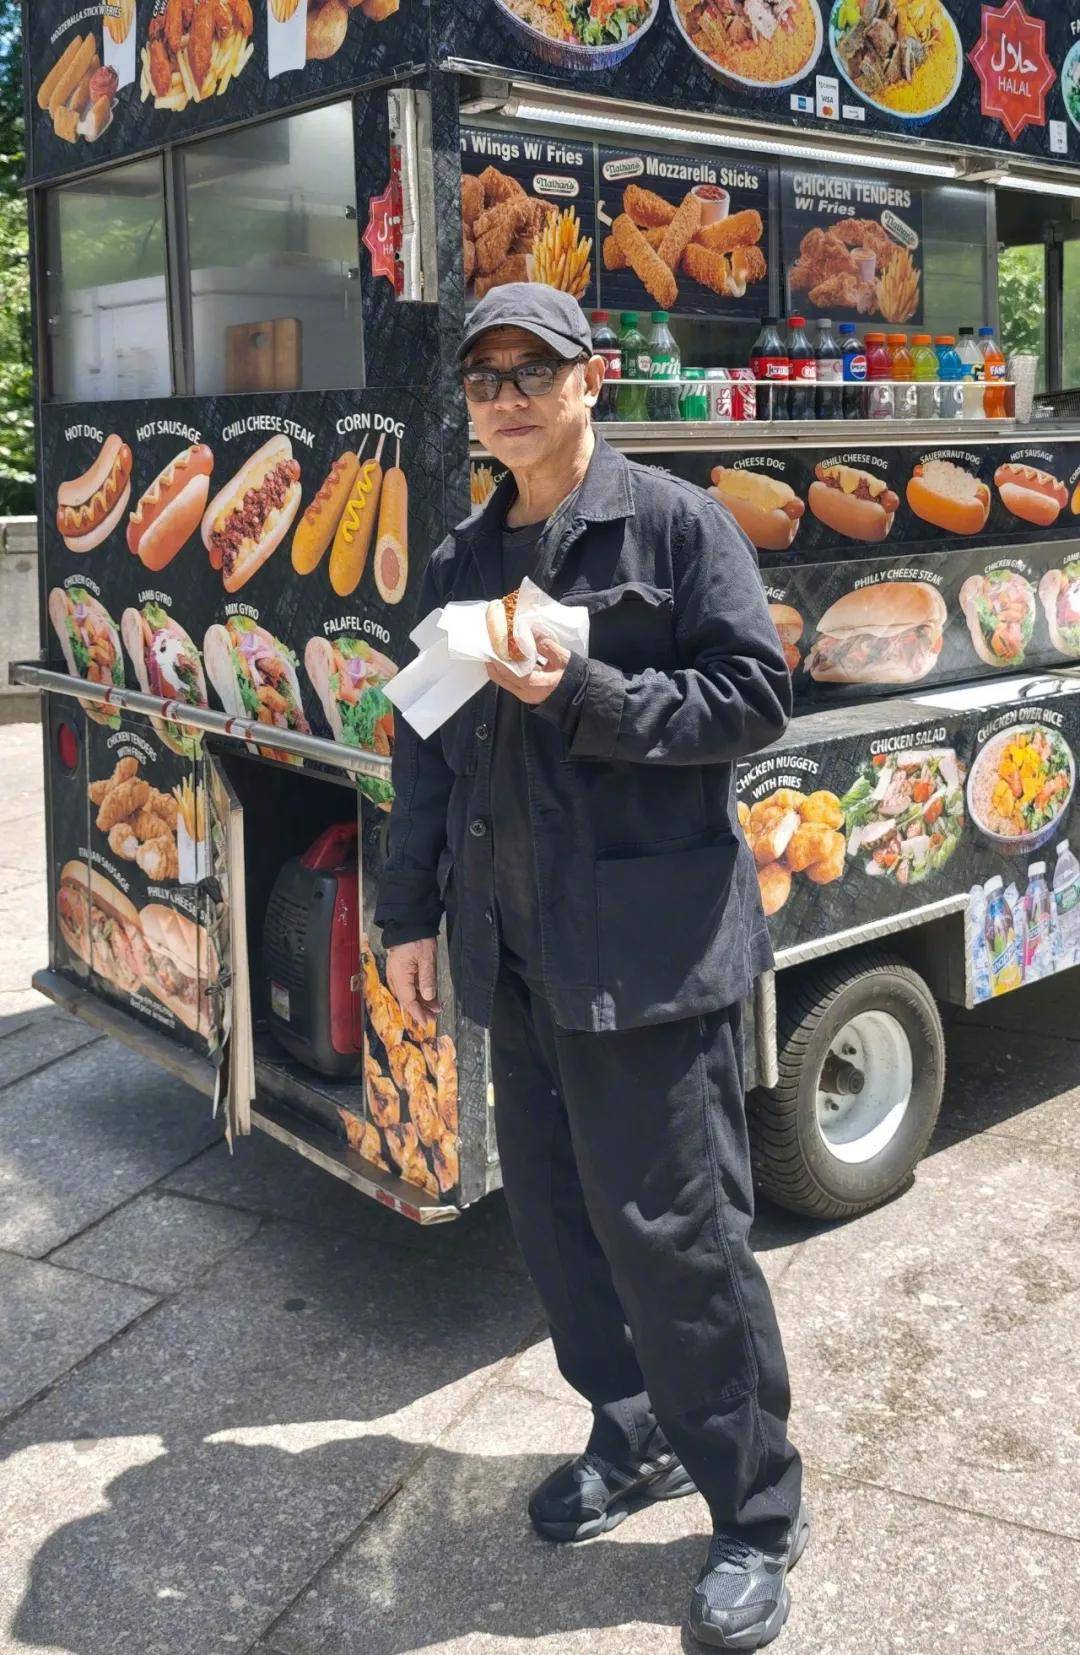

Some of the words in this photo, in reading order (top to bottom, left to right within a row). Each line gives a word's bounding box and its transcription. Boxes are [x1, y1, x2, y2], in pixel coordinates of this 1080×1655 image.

[990, 32, 1038, 74] حلال
[998, 76, 1031, 97] HALAL
[471, 135, 520, 161] Wings
[523, 142, 543, 160] W/
[547, 145, 584, 166] Fries
[536, 177, 575, 191] Nathan's
[646, 157, 717, 184] Mozzarella
[720, 168, 759, 190] Sticks
[793, 175, 851, 200] CHICKEN
[854, 183, 911, 208] TENDERS
[795, 197, 814, 211] W/
[817, 199, 855, 216] Fries
[65, 424, 82, 441] HOT
[83, 424, 103, 443] DOG
[136, 423, 157, 442] HOT
[157, 420, 202, 445] SAUSAGE
[222, 419, 246, 442] CHILI
[247, 415, 282, 431] CHEESE
[283, 419, 315, 448] STEAK
[336, 413, 371, 435] CORN
[374, 414, 406, 439] DOG
[733, 457, 766, 471] CHEESE
[766, 457, 786, 471] DOG
[820, 455, 842, 469] CHILI
[842, 453, 870, 464] CHEESE
[871, 456, 889, 470] DOG
[920, 450, 965, 465] SAUERKRAUT
[965, 451, 981, 465] DOG
[1010, 450, 1025, 461] HOT
[1024, 449, 1054, 462] SAUSAGE
[63, 573, 86, 589] CHICKEN
[84, 577, 101, 596] GYRO
[854, 571, 886, 589] PHILLY
[886, 568, 919, 580] CHEESE
[918, 569, 944, 586] STEAK
[138, 590, 156, 603] LAMB
[155, 591, 173, 607] GYRO
[225, 603, 239, 617] MIX
[239, 603, 259, 620] GYRO
[323, 616, 362, 635] FALAFEL
[363, 619, 391, 643] GYRO
[976, 709, 1018, 742] CHICKEN
[1018, 706, 1043, 721] OVER
[1042, 708, 1064, 727] RICE
[870, 733, 914, 755] CHICKEN
[914, 727, 946, 746] SALAD
[735, 758, 774, 793] CHICKEN
[775, 755, 820, 774] NUGGETS
[752, 778, 777, 799] WITH
[778, 775, 802, 788] FRIES
[146, 886, 170, 900] PHILLY
